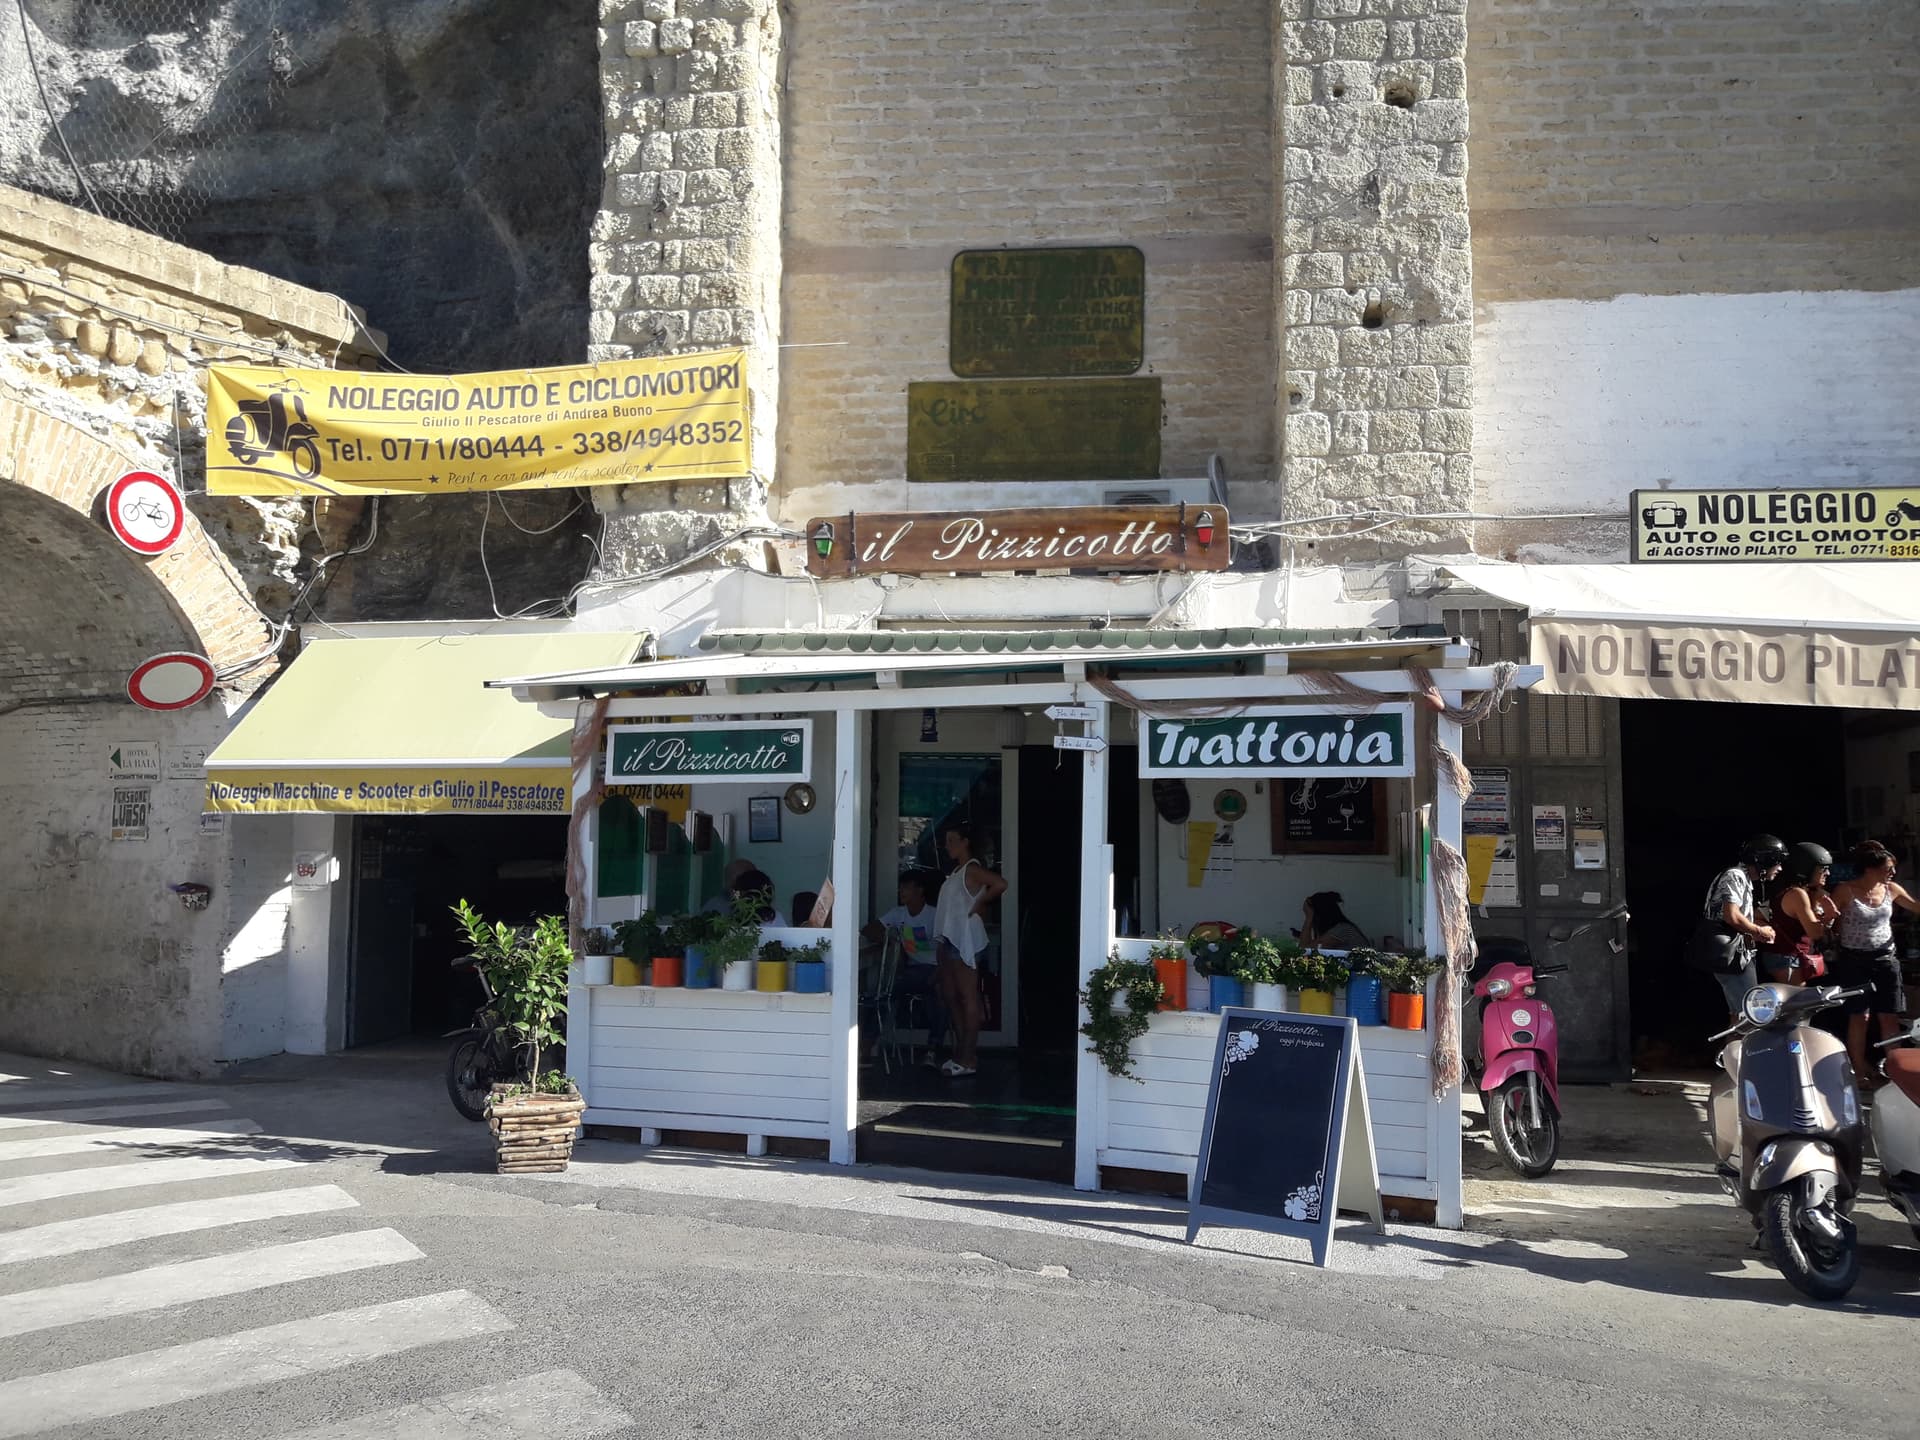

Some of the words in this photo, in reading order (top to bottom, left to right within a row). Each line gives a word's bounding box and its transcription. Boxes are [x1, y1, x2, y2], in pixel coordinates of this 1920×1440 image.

[328, 385, 458, 411] NOLEGGIO
[466, 383, 539, 410] AUTO
[546, 382, 560, 406] E
[569, 363, 741, 404] CICLOMOTORI
[422, 416, 456, 428] Giulio
[478, 412, 541, 427] Pescatore
[546, 411, 558, 422] di
[563, 407, 608, 421] Andrea
[613, 405, 652, 418] Buono
[327, 437, 372, 464] Tel.
[381, 435, 544, 462] 0771/80444
[572, 421, 743, 456] 338/4948352
[494, 473, 516, 482] car
[521, 468, 546, 481] and
[593, 464, 640, 477] scooter
[1698, 492, 1876, 525] NOLEGGIO
[862, 521, 914, 562] il
[932, 517, 1173, 562] Pizzicotto
[1646, 531, 1718, 544] AUTO
[1727, 532, 1741, 543] e
[1646, 546, 1660, 557] di
[1663, 545, 1742, 557] AGOSTINO
[1744, 544, 1797, 556] PILATO
[1815, 545, 1846, 555] TEL.
[1558, 634, 1785, 684] NOLEGGIO
[128, 749, 151, 757] HOTEL
[1156, 719, 1395, 766] Trattoria
[123, 759, 132, 769] LA
[135, 759, 157, 769] BAIA
[623, 739, 656, 772] il
[650, 738, 788, 771] Pizzicotto
[209, 783, 271, 803] Noleggio
[273, 782, 339, 800] Macchine
[344, 787, 353, 800] e
[358, 782, 414, 799] Scooter
[419, 784, 430, 798] di
[433, 780, 475, 798] Giulio
[479, 780, 488, 798] il
[491, 781, 565, 800] Pescatore
[112, 804, 146, 827] LUISA
[452, 798, 504, 809] 0771/80444
[506, 799, 564, 811] 338/4948352
[1279, 1038, 1295, 1047] oggi
